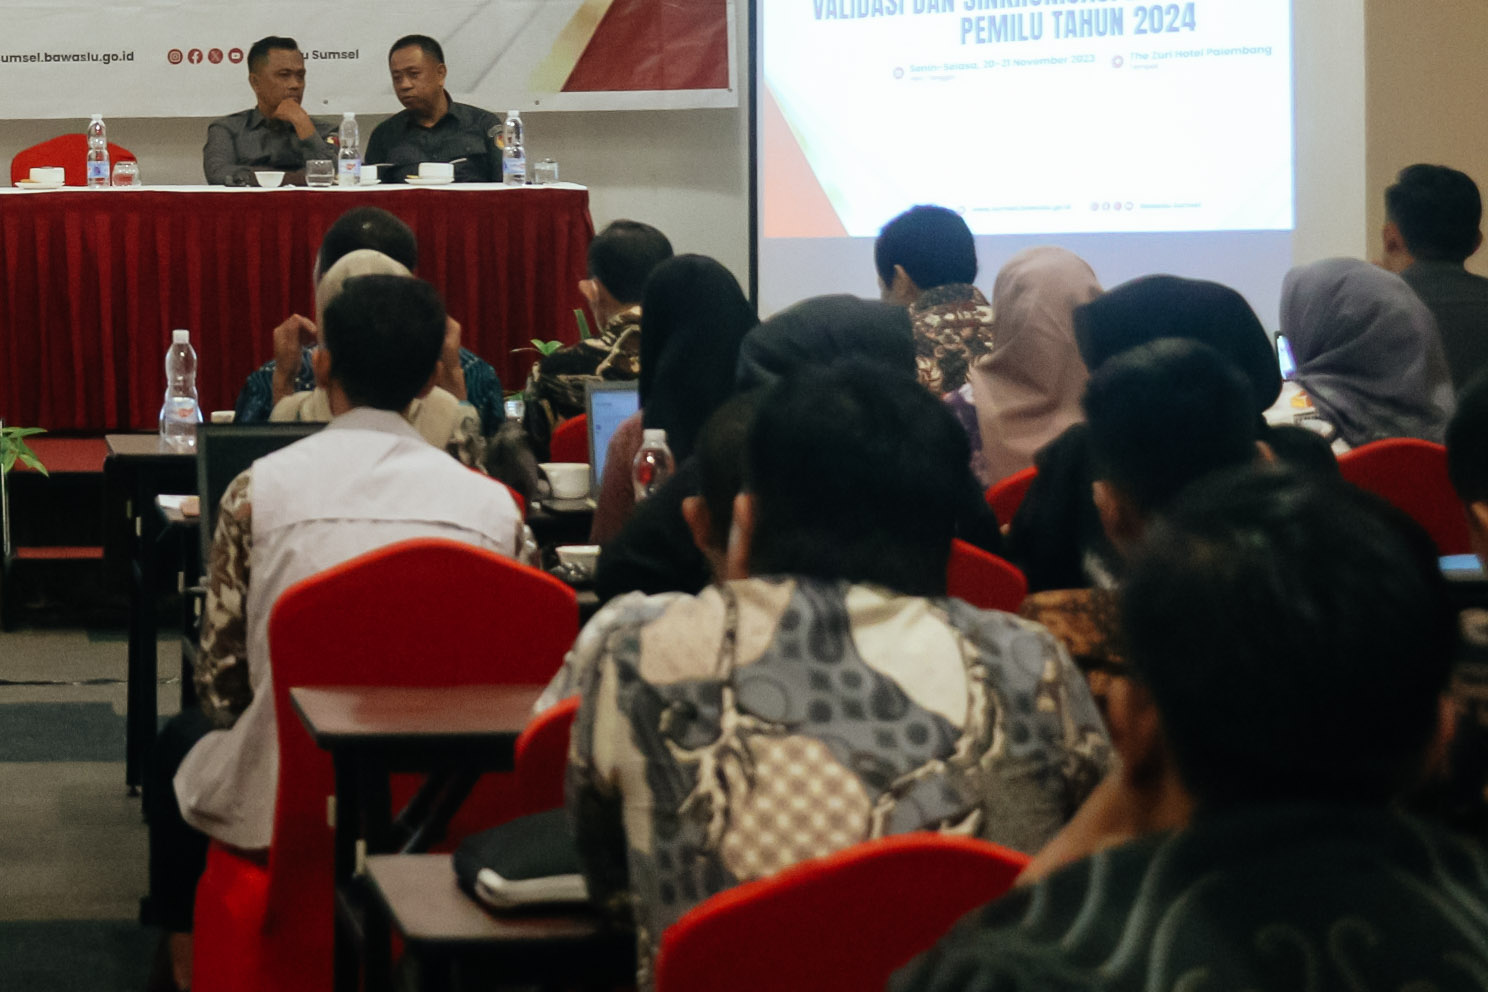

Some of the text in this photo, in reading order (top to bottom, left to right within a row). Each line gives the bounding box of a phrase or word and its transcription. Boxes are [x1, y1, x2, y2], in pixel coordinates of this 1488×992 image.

[960, 2, 1197, 45] PEMILU TAHUN 2024
[312, 49, 359, 59] Sumsel
